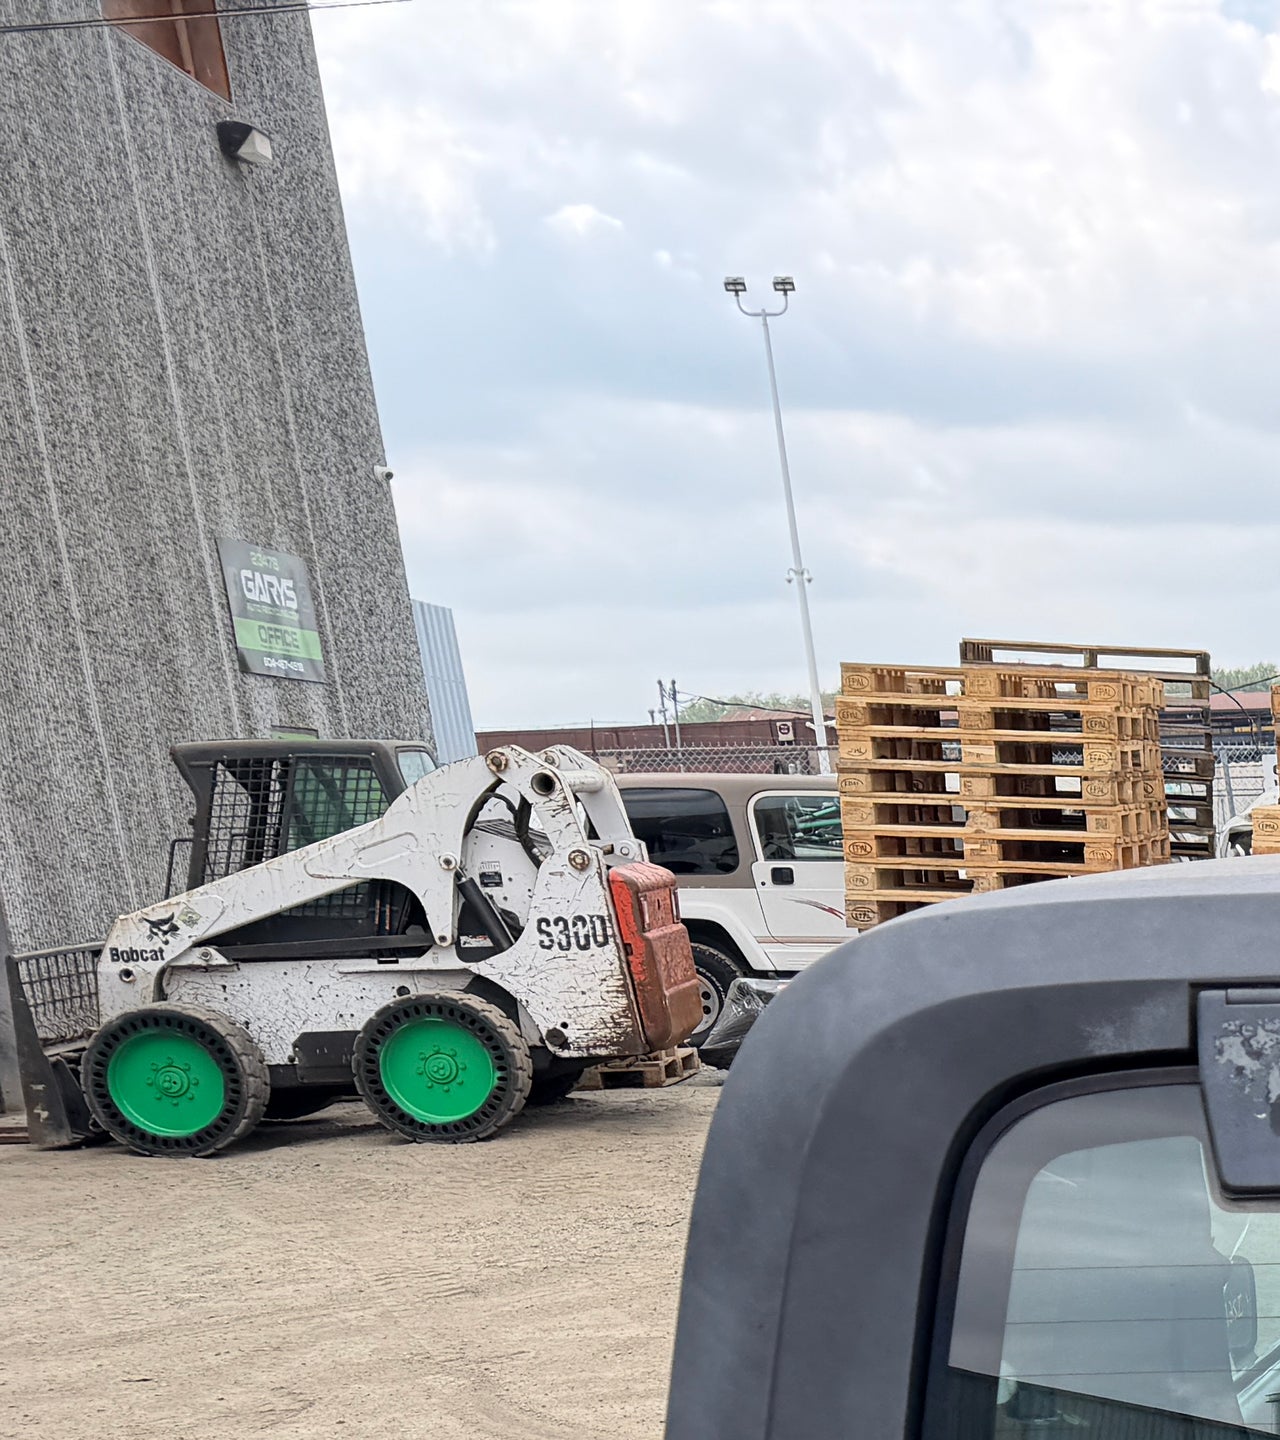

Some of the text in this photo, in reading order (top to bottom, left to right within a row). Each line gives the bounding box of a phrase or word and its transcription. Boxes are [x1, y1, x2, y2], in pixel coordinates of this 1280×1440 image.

[240, 569, 298, 610] GARYS
[258, 624, 300, 649] OFFICE
[109, 946, 165, 963] Bobcat
